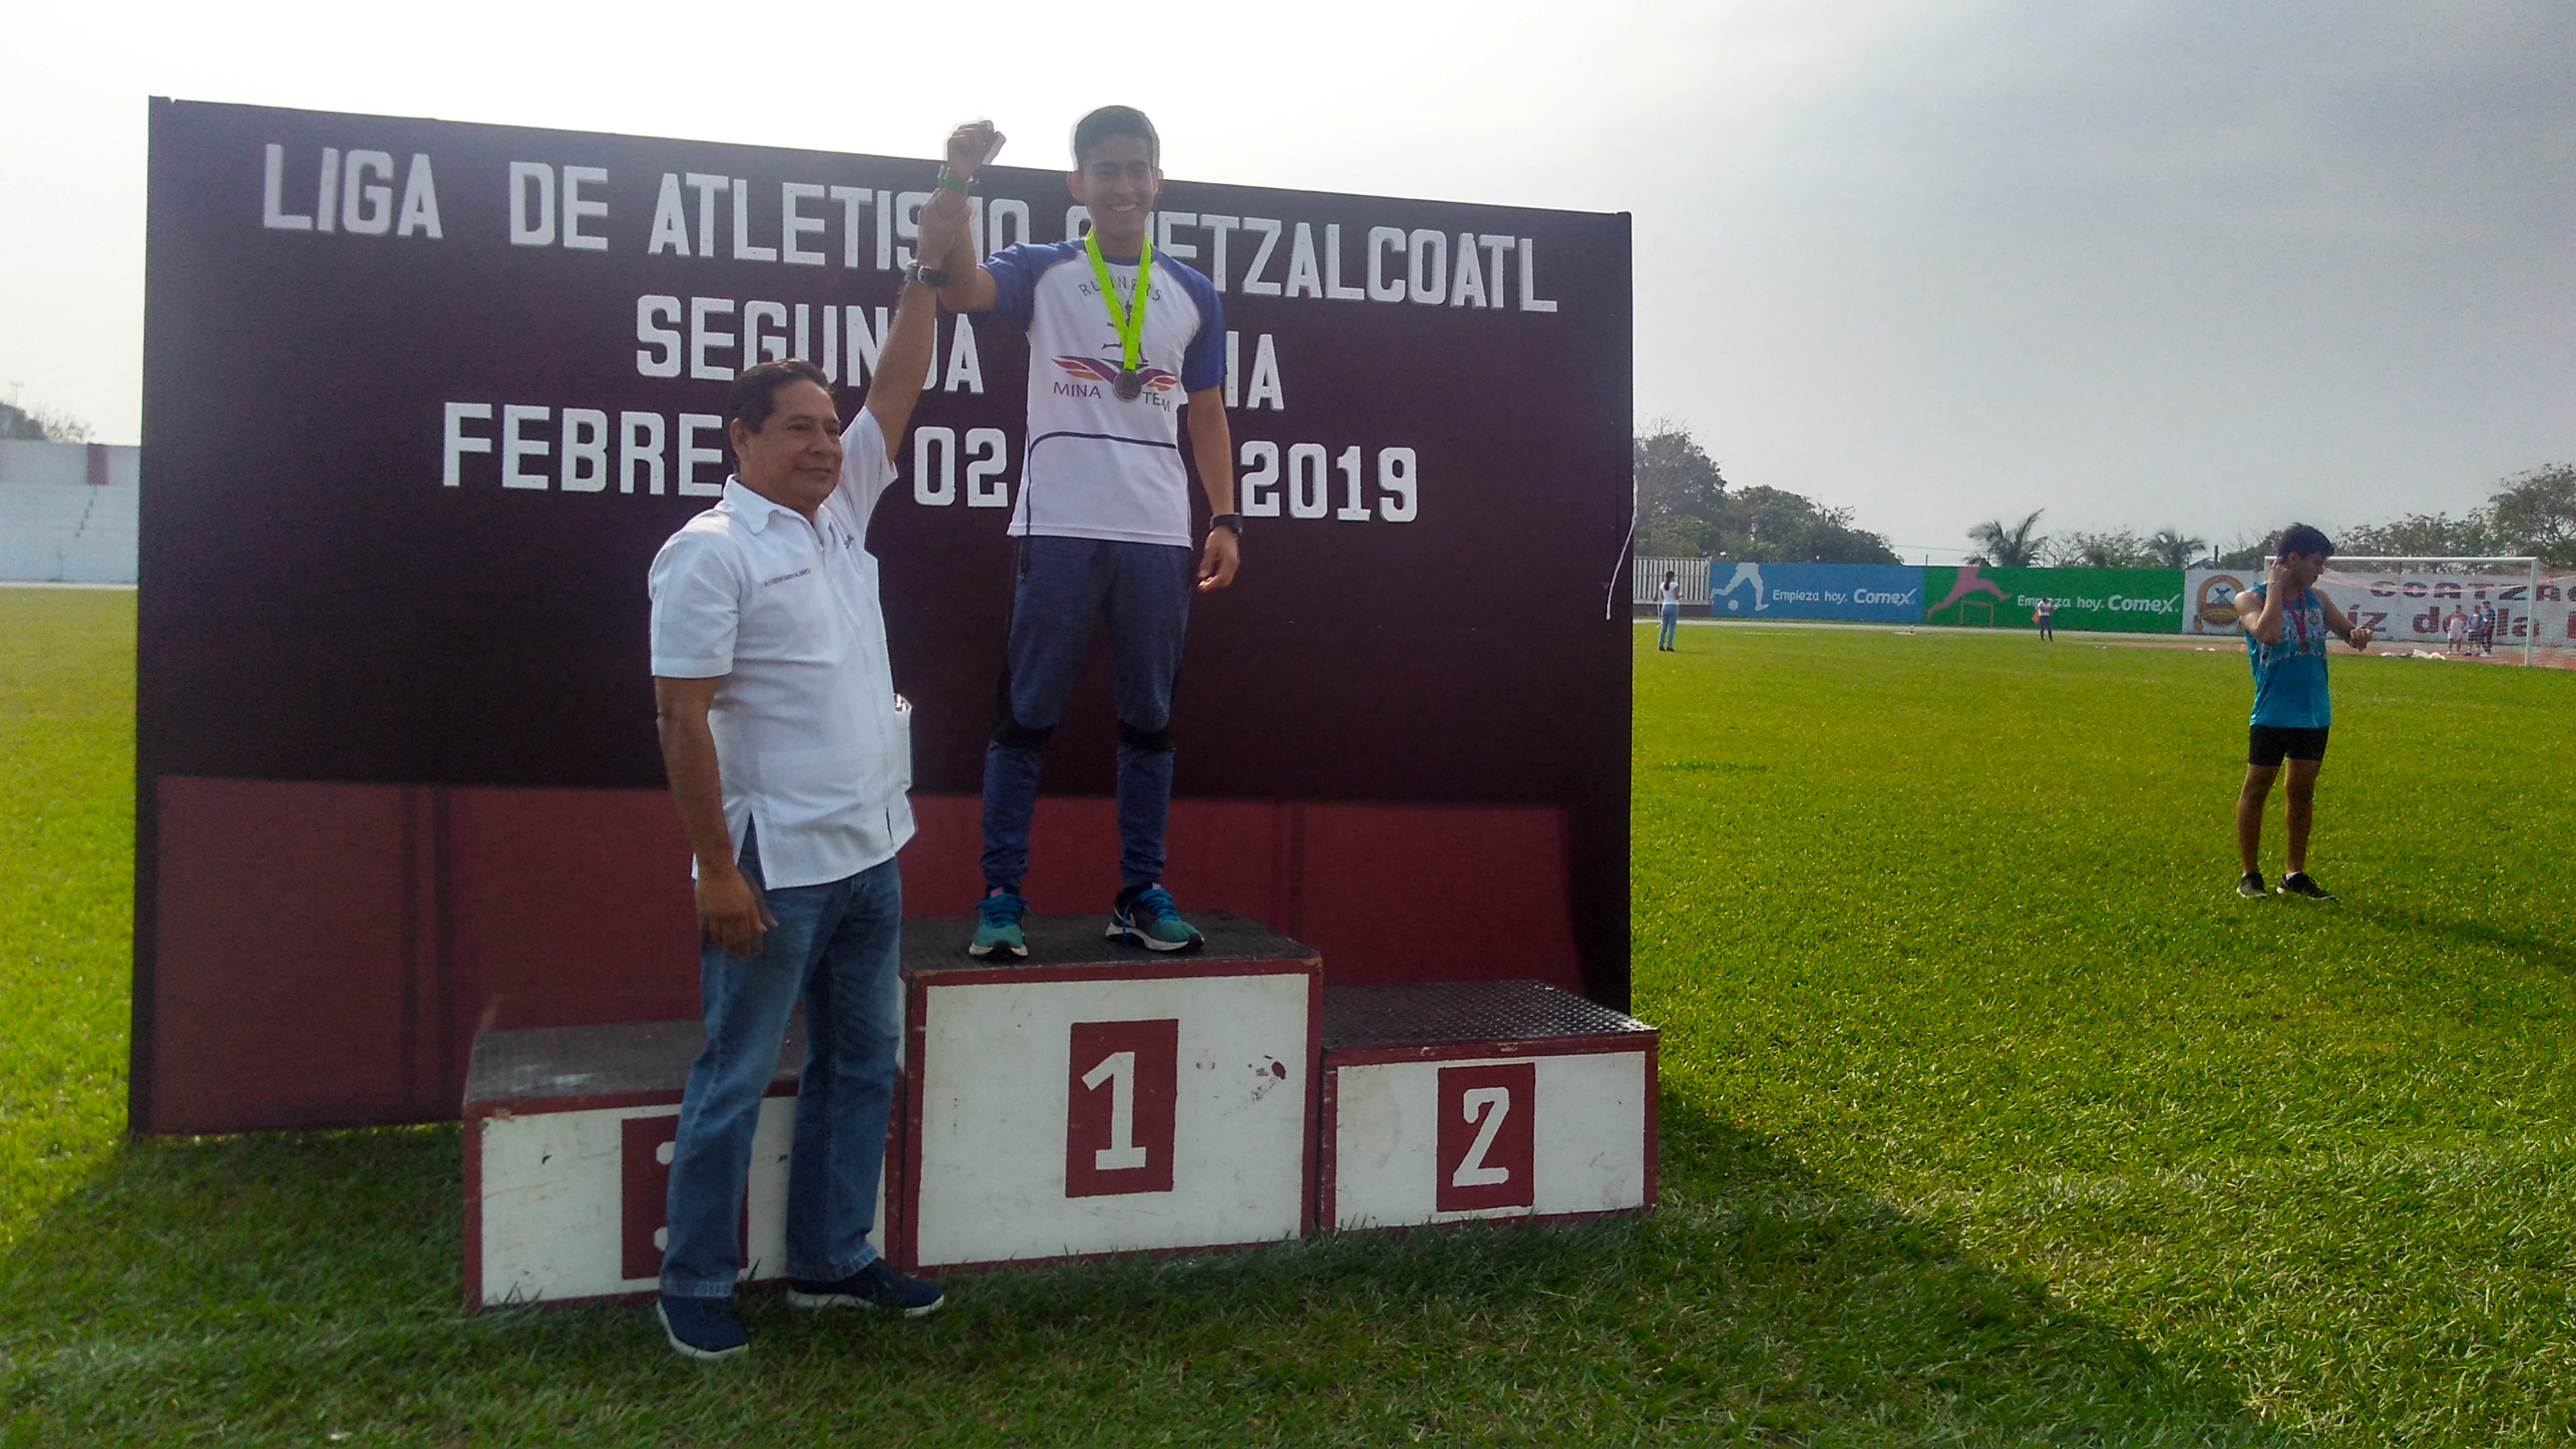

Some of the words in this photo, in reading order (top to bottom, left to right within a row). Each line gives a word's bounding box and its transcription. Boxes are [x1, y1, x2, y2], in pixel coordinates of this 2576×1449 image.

[264, 144, 444, 240] LIGA
[508, 161, 608, 251] DE
[647, 173, 1031, 273] ATLETISO
[1065, 204, 1558, 313] ETZALCOATL
[636, 294, 984, 394] SEGUNA
[1054, 381, 1102, 399] MINA
[1142, 391, 1170, 413] TEM
[443, 402, 723, 497] FEBRE
[913, 425, 1009, 508] 02
[1240, 440, 1418, 523] 2019
[1773, 589, 1820, 604] Empieza
[1824, 590, 1848, 605] hoy.
[1853, 588, 1918, 607] Comex
[2017, 594, 2071, 610] Empza
[2076, 596, 2104, 612] hoy.
[2107, 593, 2181, 615] Comex
[1080, 1050, 1147, 1170] 1
[1451, 1086, 1510, 1187] 2
